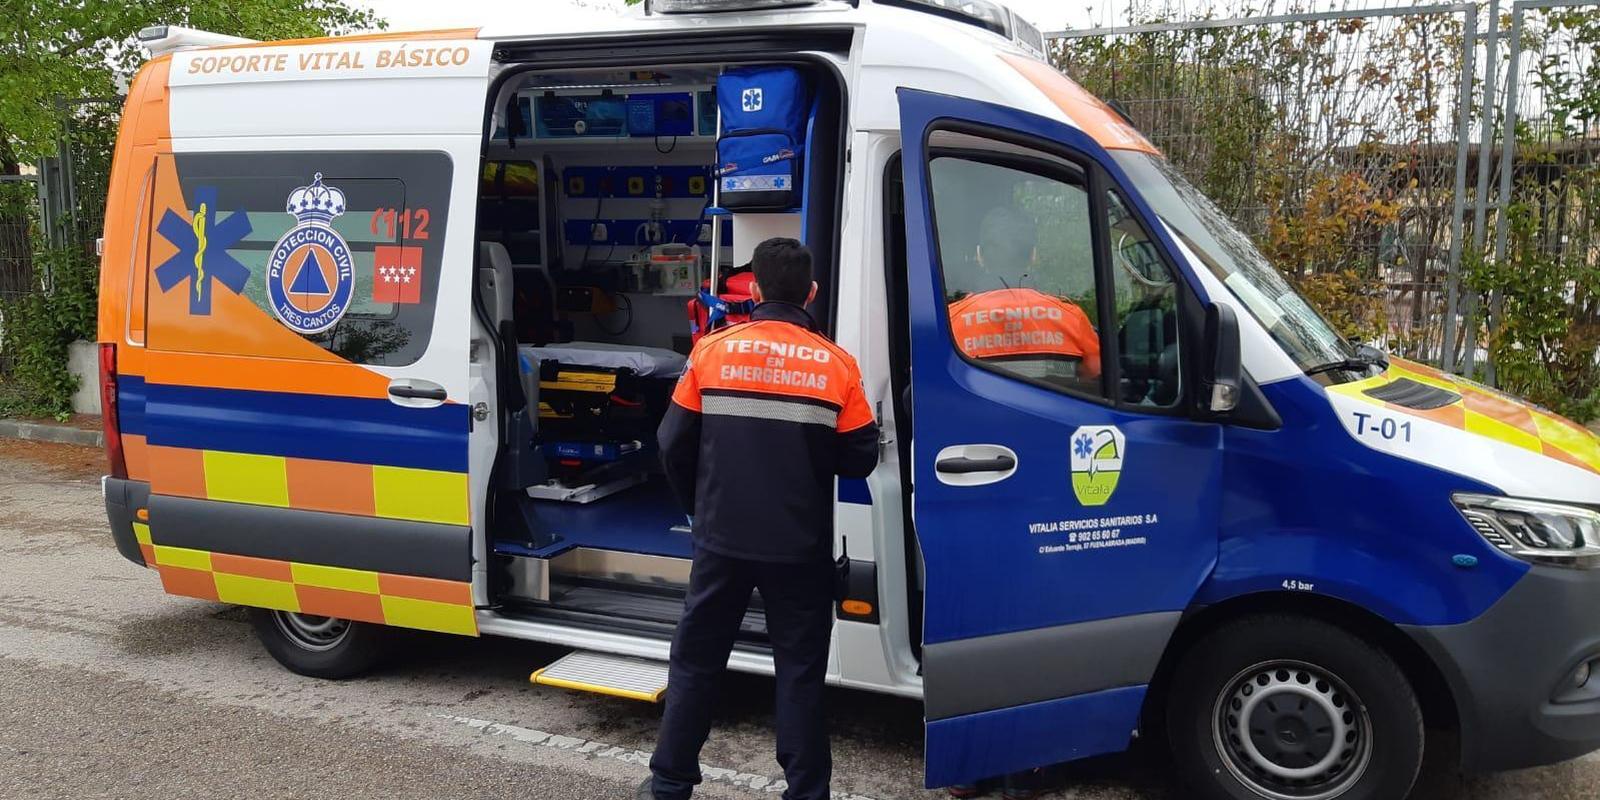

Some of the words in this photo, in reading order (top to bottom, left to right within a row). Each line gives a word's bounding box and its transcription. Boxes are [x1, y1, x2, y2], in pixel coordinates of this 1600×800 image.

[188, 54, 289, 75] SOPORTE
[297, 50, 364, 71] VITAL
[375, 43, 470, 68] BÁSICO
[383, 208, 430, 240] 112
[271, 229, 336, 279] PROTECCION
[333, 246, 351, 282] CIVIL
[280, 304, 302, 325] TRES
[302, 303, 341, 328] CANTOS
[961, 306, 1063, 327] TECNICO
[724, 339, 831, 363] TECNICO
[963, 332, 1065, 352] EMERGENCIAS
[766, 356, 785, 368] EN
[720, 365, 828, 390] EMERGENCIAS
[1352, 412, 1412, 443] T-01
[1029, 522, 1058, 534] VITALIA
[1058, 518, 1099, 531] SERVICIOS
[1099, 515, 1143, 528] SANITARIOS
[1078, 532, 1092, 542] 902
[1092, 531, 1101, 540] 65
[1282, 579, 1296, 590] 4,5
[1298, 581, 1315, 591] bar
